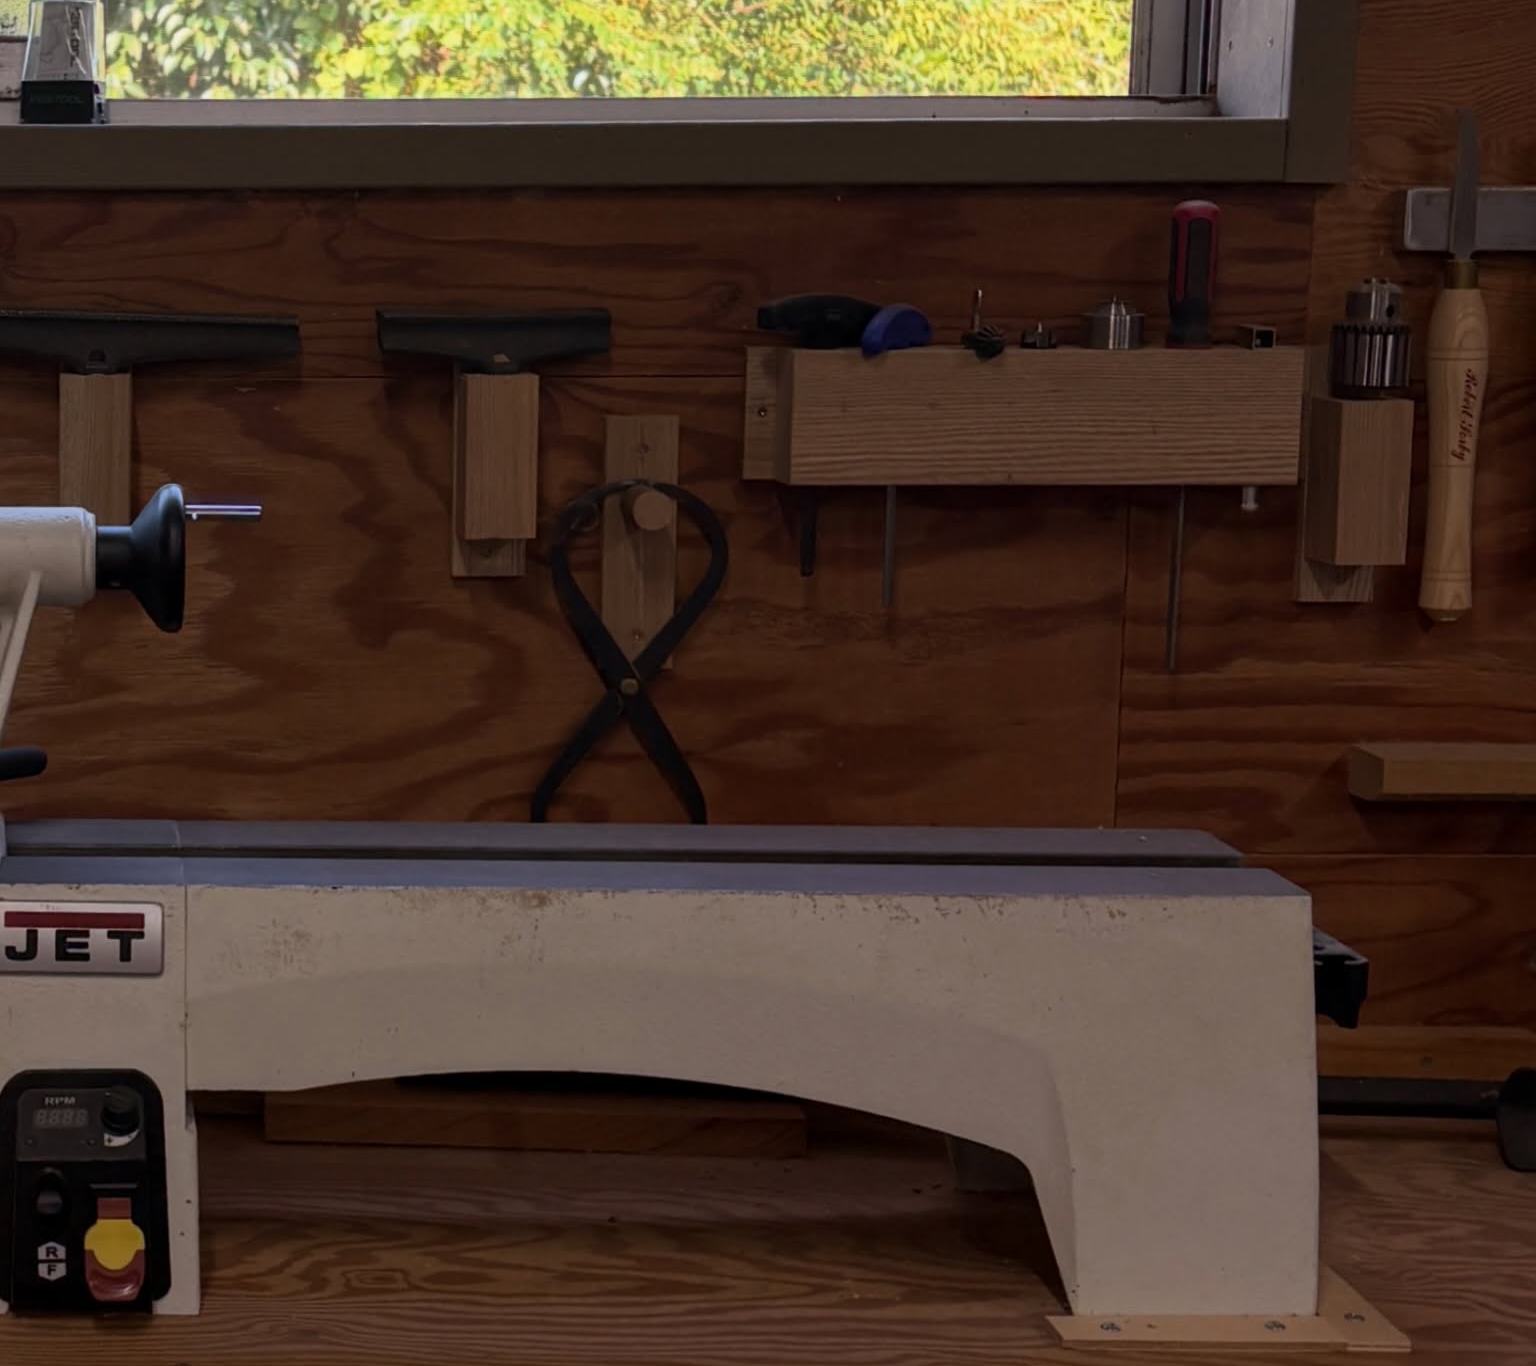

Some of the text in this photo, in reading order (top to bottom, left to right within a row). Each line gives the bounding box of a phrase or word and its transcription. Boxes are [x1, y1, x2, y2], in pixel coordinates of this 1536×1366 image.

[5, 929, 145, 962] JET
[45, 1096, 76, 1105] RPM
[46, 1246, 58, 1258] R
[47, 1264, 56, 1275] F
